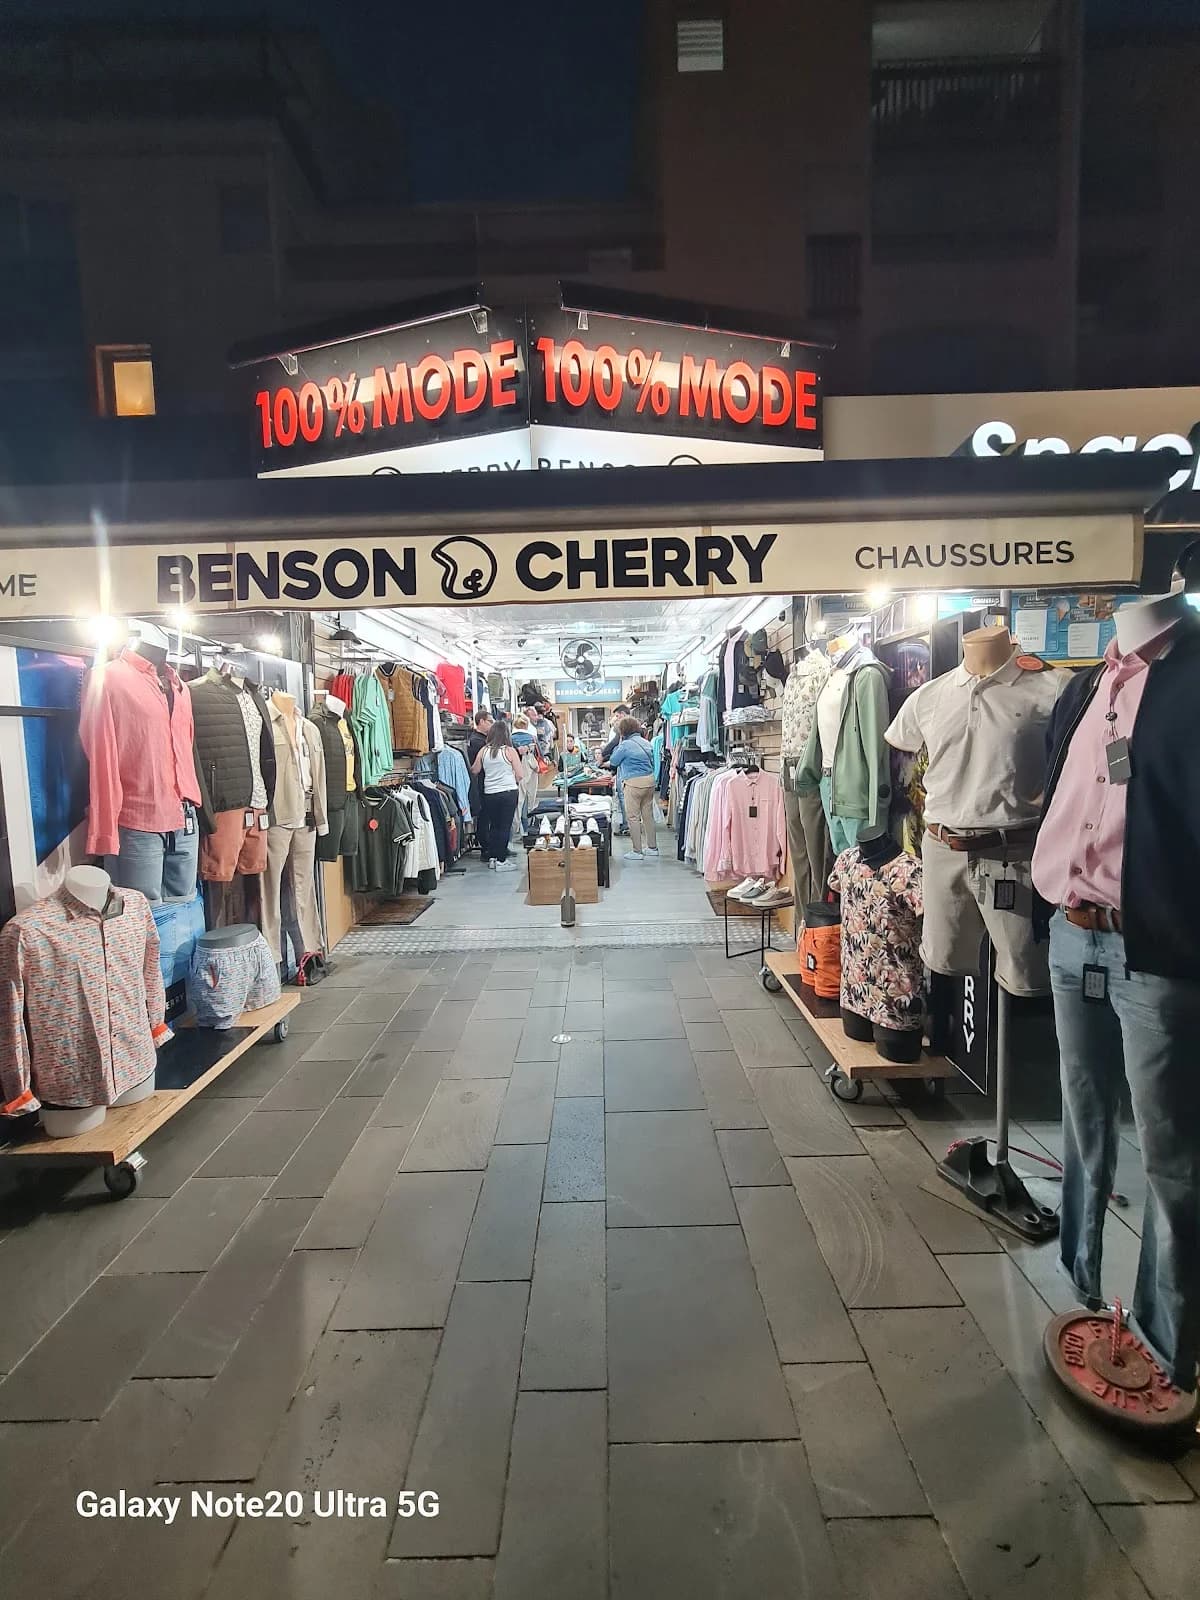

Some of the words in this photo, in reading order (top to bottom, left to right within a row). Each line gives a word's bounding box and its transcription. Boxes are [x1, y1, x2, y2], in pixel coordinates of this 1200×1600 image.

[254, 372, 366, 449] 100%
[372, 339, 517, 430] MODE
[536, 337, 672, 416] 100%
[679, 355, 818, 430] MODE
[157, 547, 417, 604] BENSON
[515, 533, 778, 592] CHERRY
[855, 539, 1075, 570] CHAUSSURES
